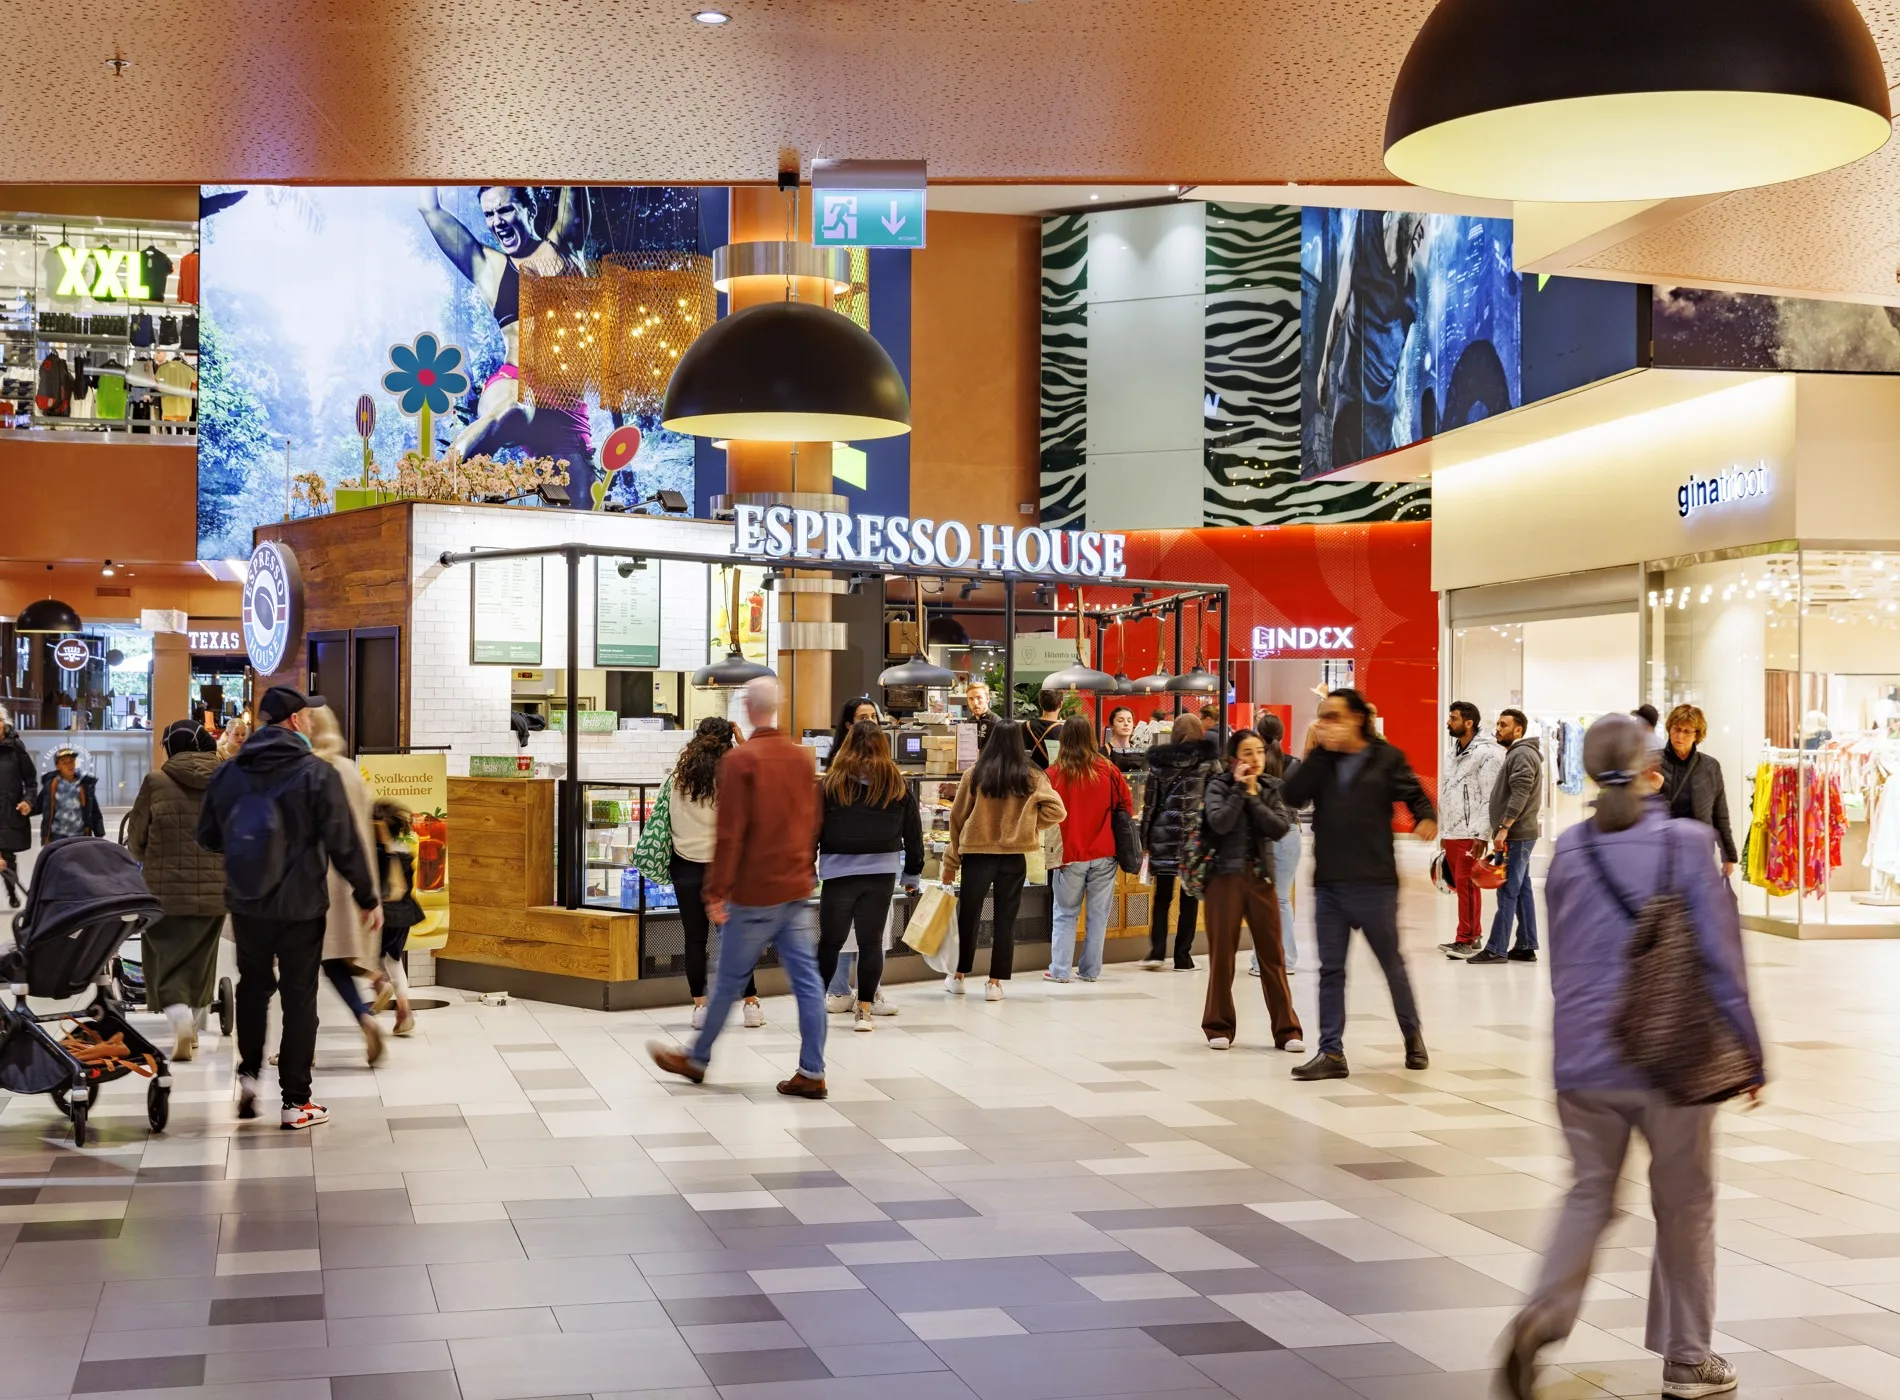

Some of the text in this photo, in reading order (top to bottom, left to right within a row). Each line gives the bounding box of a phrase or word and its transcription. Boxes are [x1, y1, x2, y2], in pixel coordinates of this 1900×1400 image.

[56, 246, 150, 299] XXL
[735, 503, 1127, 578] ESPRESSO HOUSE
[245, 548, 284, 597] ESPRESSO
[188, 631, 240, 650] TEXAS
[249, 634, 279, 667] HOUSE
[1252, 626, 1354, 650] LINDEX
[374, 773, 433, 784] Svalkande
[376, 785, 433, 796] vitaminer
